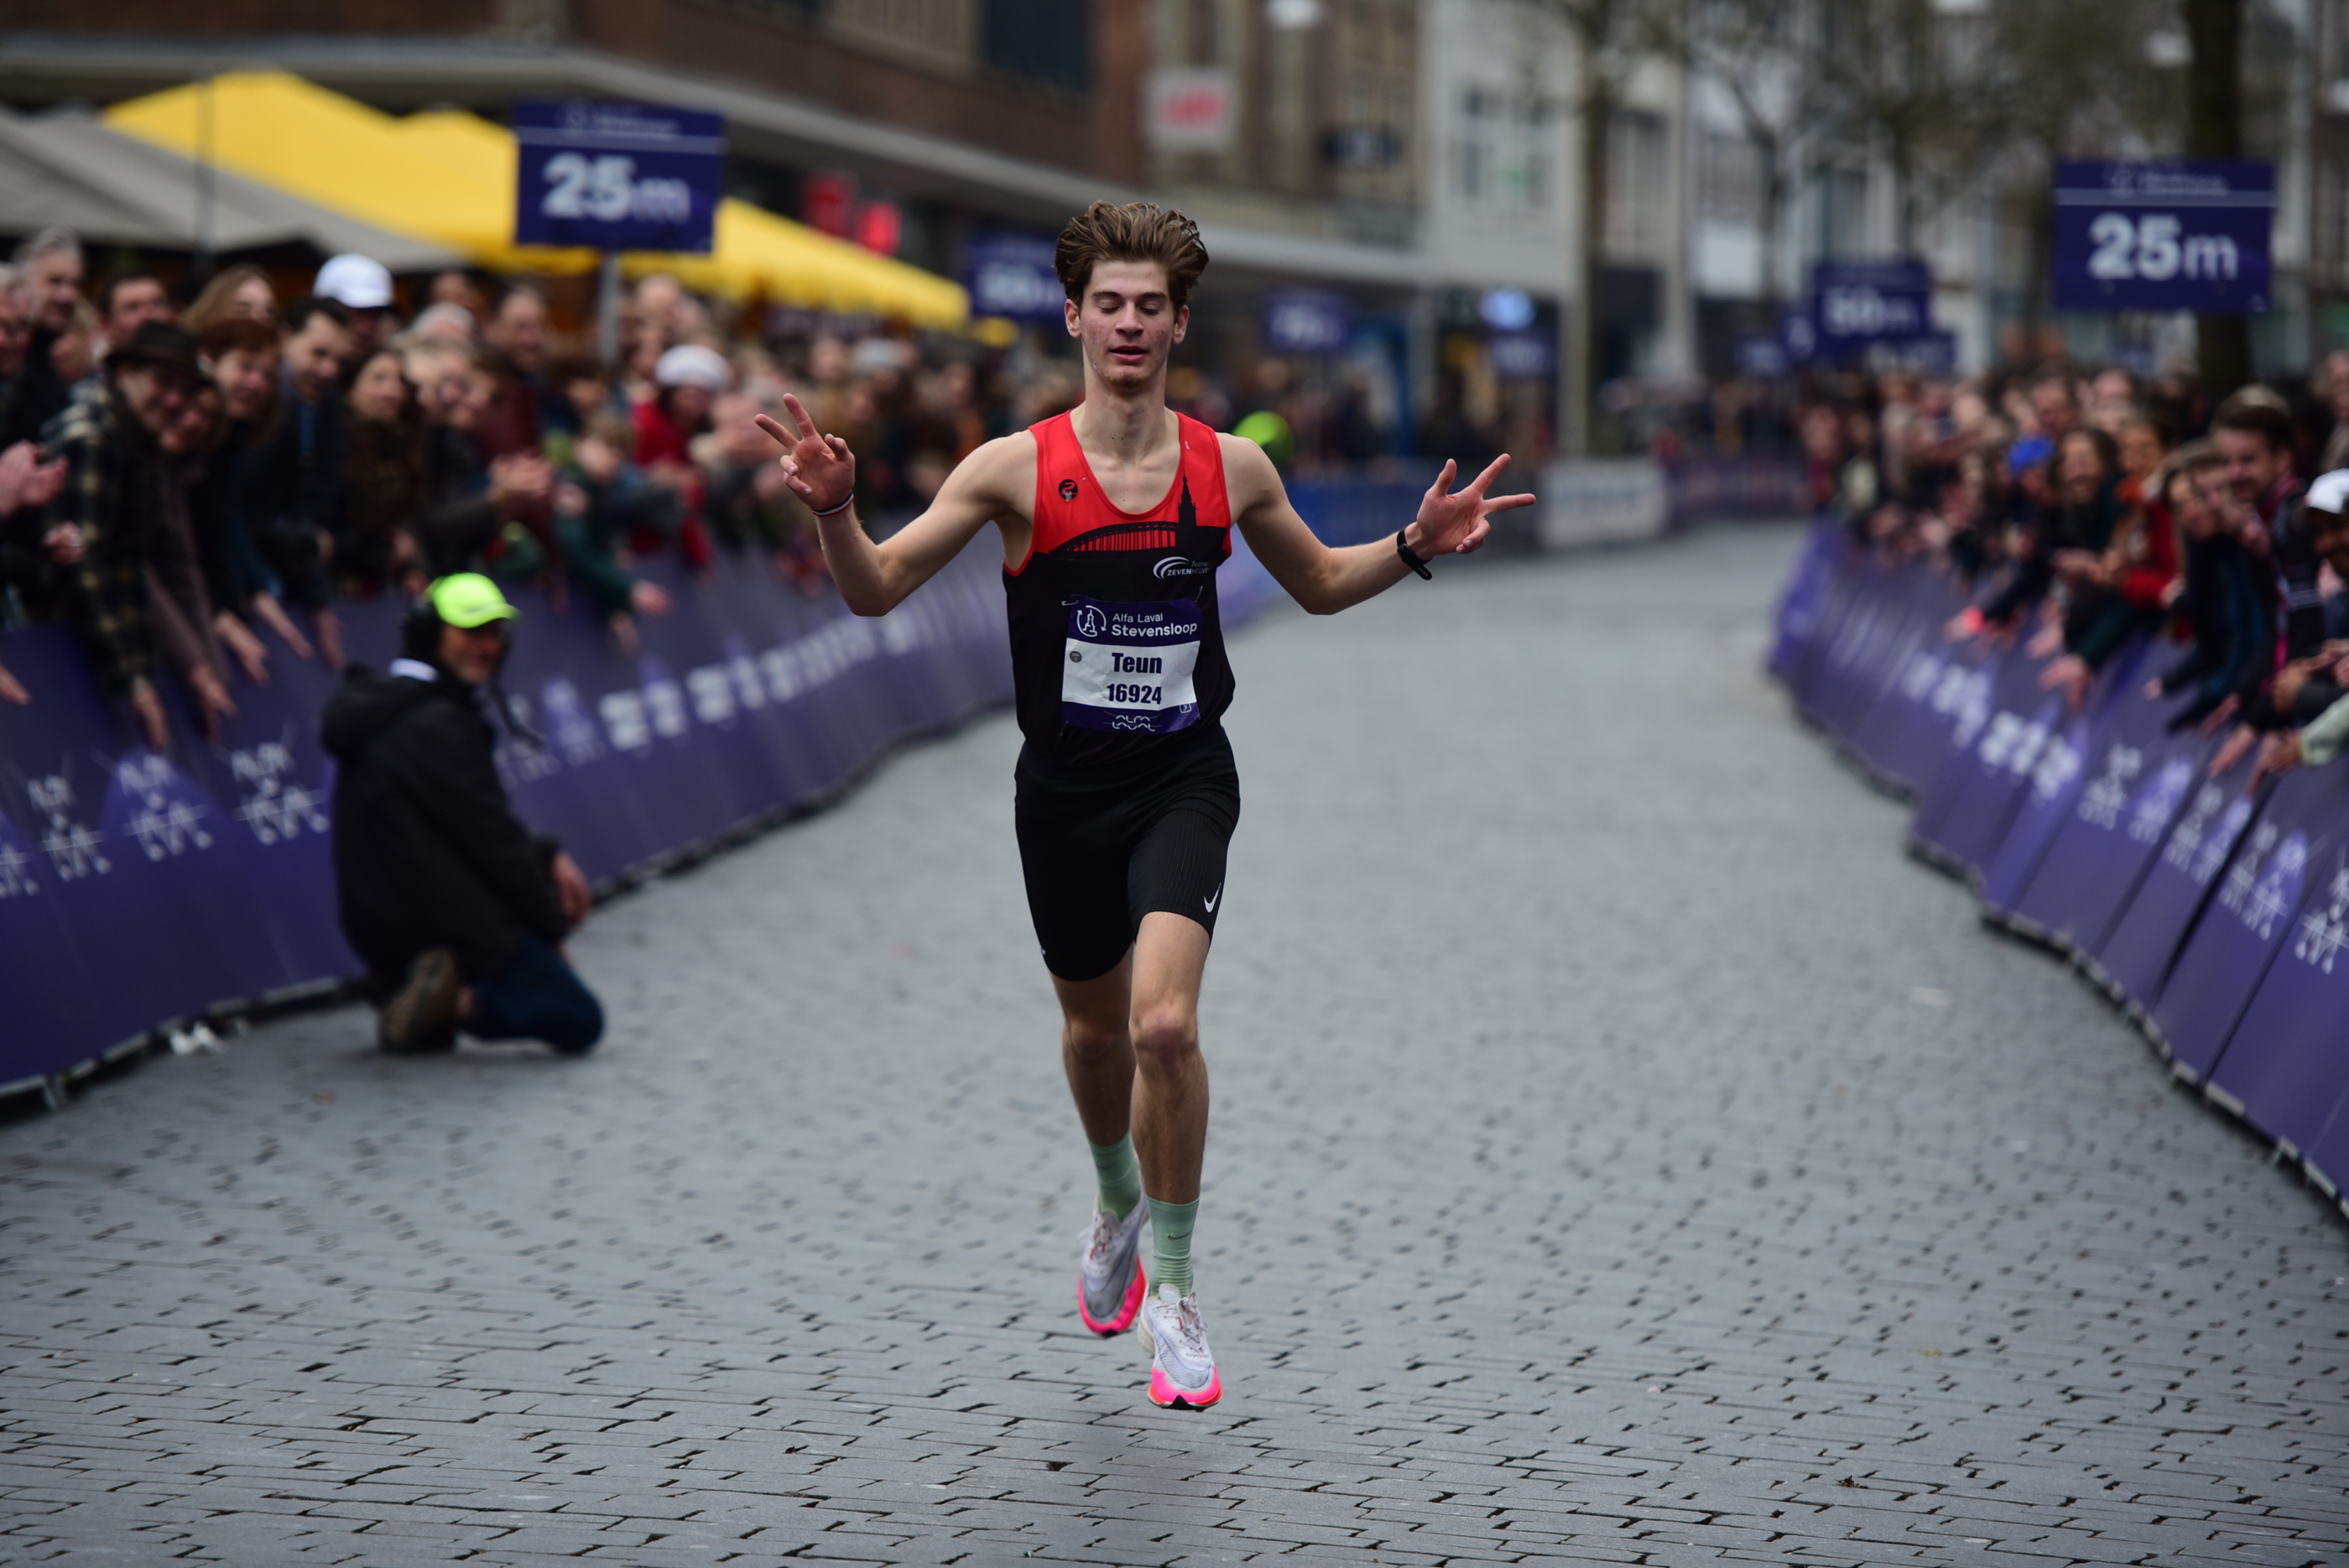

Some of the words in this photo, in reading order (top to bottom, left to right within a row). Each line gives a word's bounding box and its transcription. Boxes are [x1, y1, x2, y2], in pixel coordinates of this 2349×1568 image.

[542, 151, 692, 224] 25m
[2087, 211, 2238, 281] 25m
[1112, 613, 1133, 623] Alfa
[1138, 612, 1163, 623] Laval
[1112, 623, 1197, 637] Stevensloop
[1112, 653, 1162, 674] Teun
[1107, 684, 1162, 704] 16924
